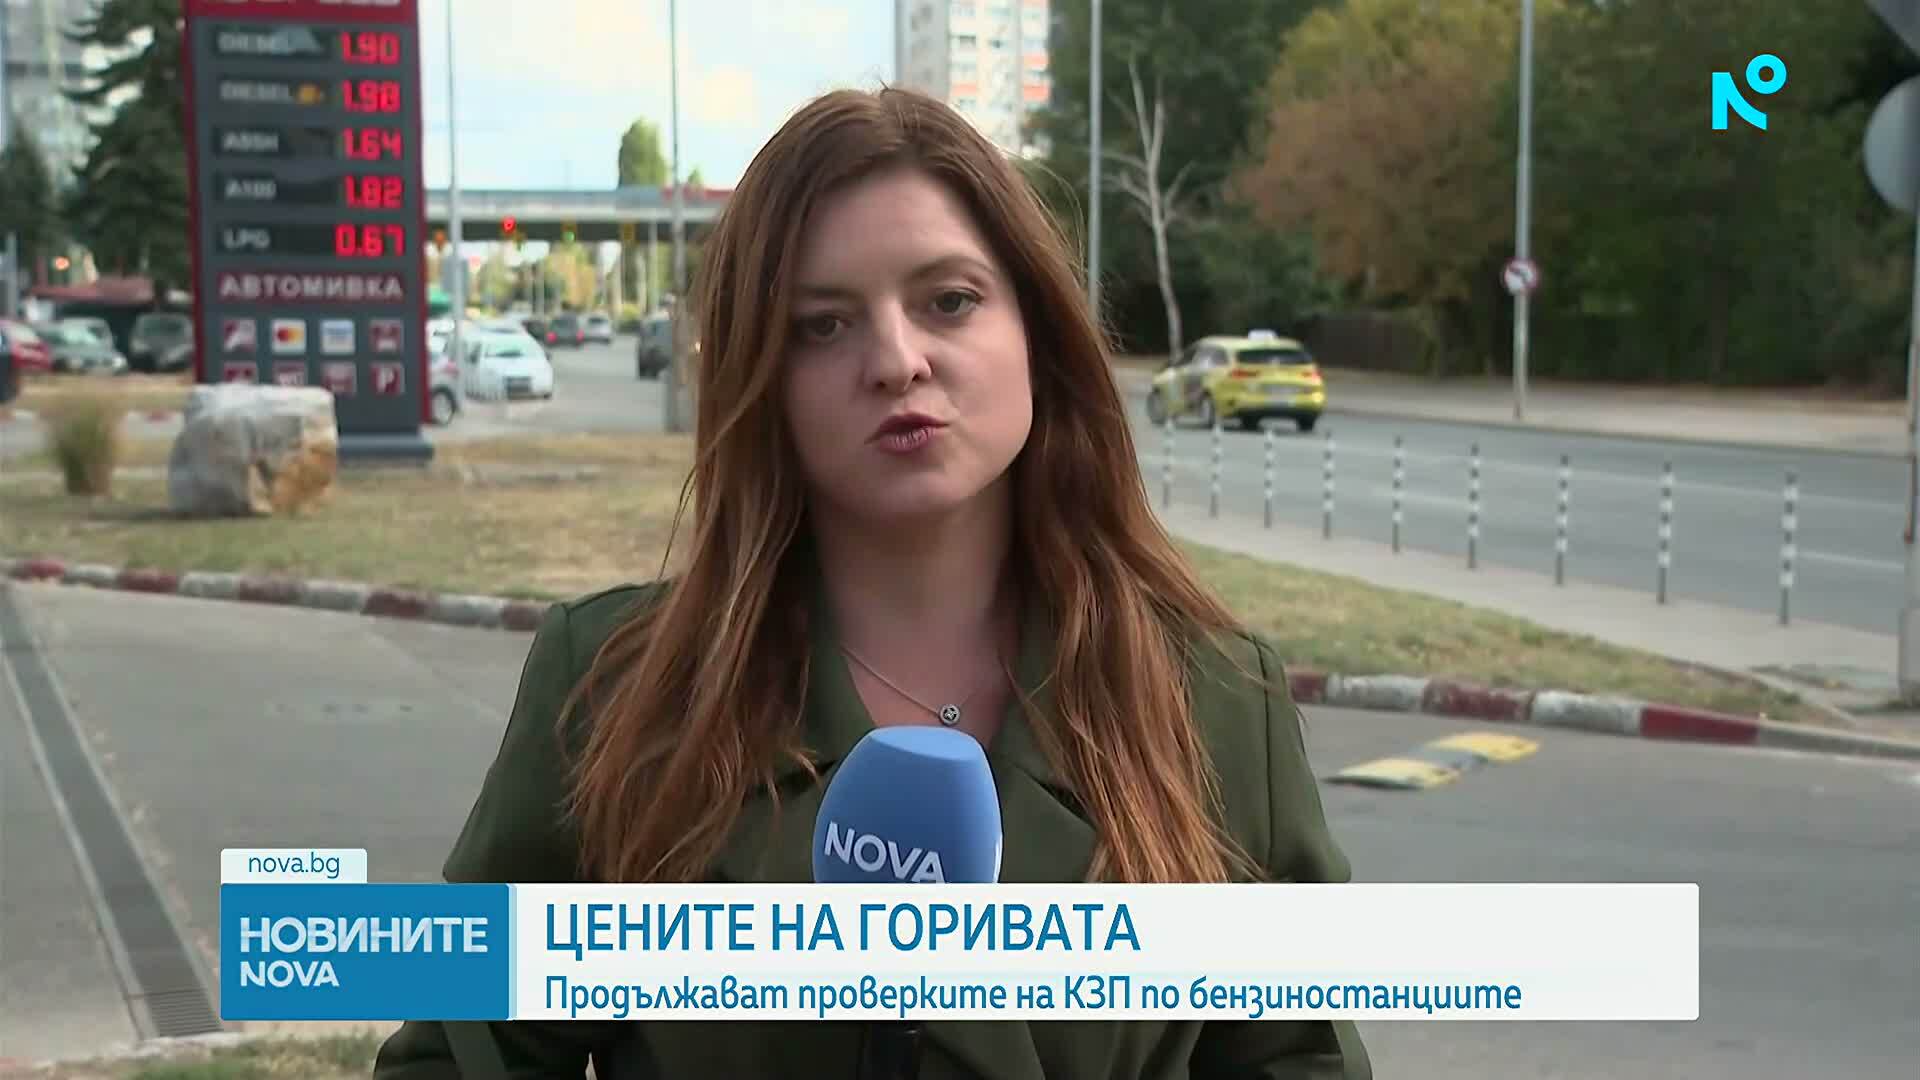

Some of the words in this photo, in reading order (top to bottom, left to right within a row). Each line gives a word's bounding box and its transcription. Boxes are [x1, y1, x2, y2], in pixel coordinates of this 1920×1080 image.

[340, 31, 400, 65] 1.90
[342, 80, 401, 113] 1.98
[342, 127, 403, 161] 1.64
[345, 175, 404, 209] 1.82
[223, 228, 271, 250] LPG
[335, 224, 405, 258] 0.67
[220, 273, 403, 298] АВТОМИВКА
[824, 821, 947, 883] NOVA
